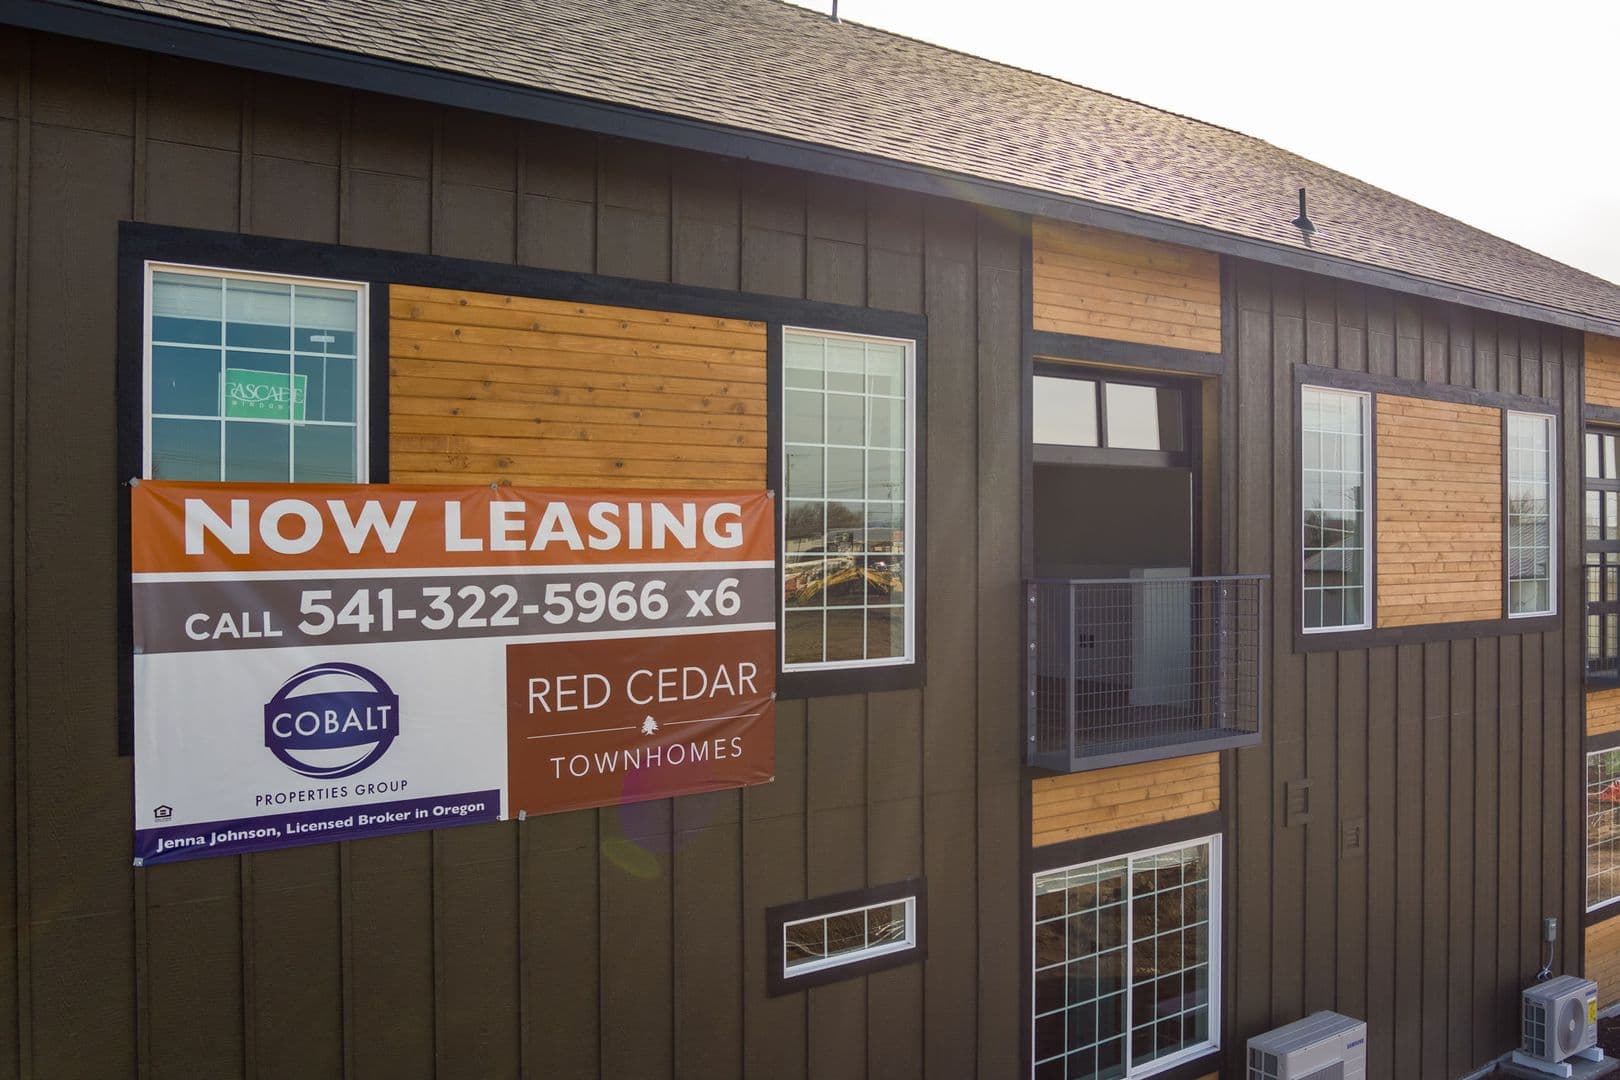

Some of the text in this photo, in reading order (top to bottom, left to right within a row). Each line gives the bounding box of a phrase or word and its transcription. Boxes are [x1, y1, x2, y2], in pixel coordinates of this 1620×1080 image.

[185, 498, 743, 555] NOW LEASING
[185, 578, 741, 641] CALL 541-322-5966 x6
[528, 662, 758, 714] RED CEDAR
[272, 705, 391, 738] COBALT
[550, 737, 742, 779] TOWNHOMES
[256, 780, 408, 806] PROPERTIES GROUP
[156, 802, 485, 853] Jenna Johnson, Licensed Broker in Oregon
